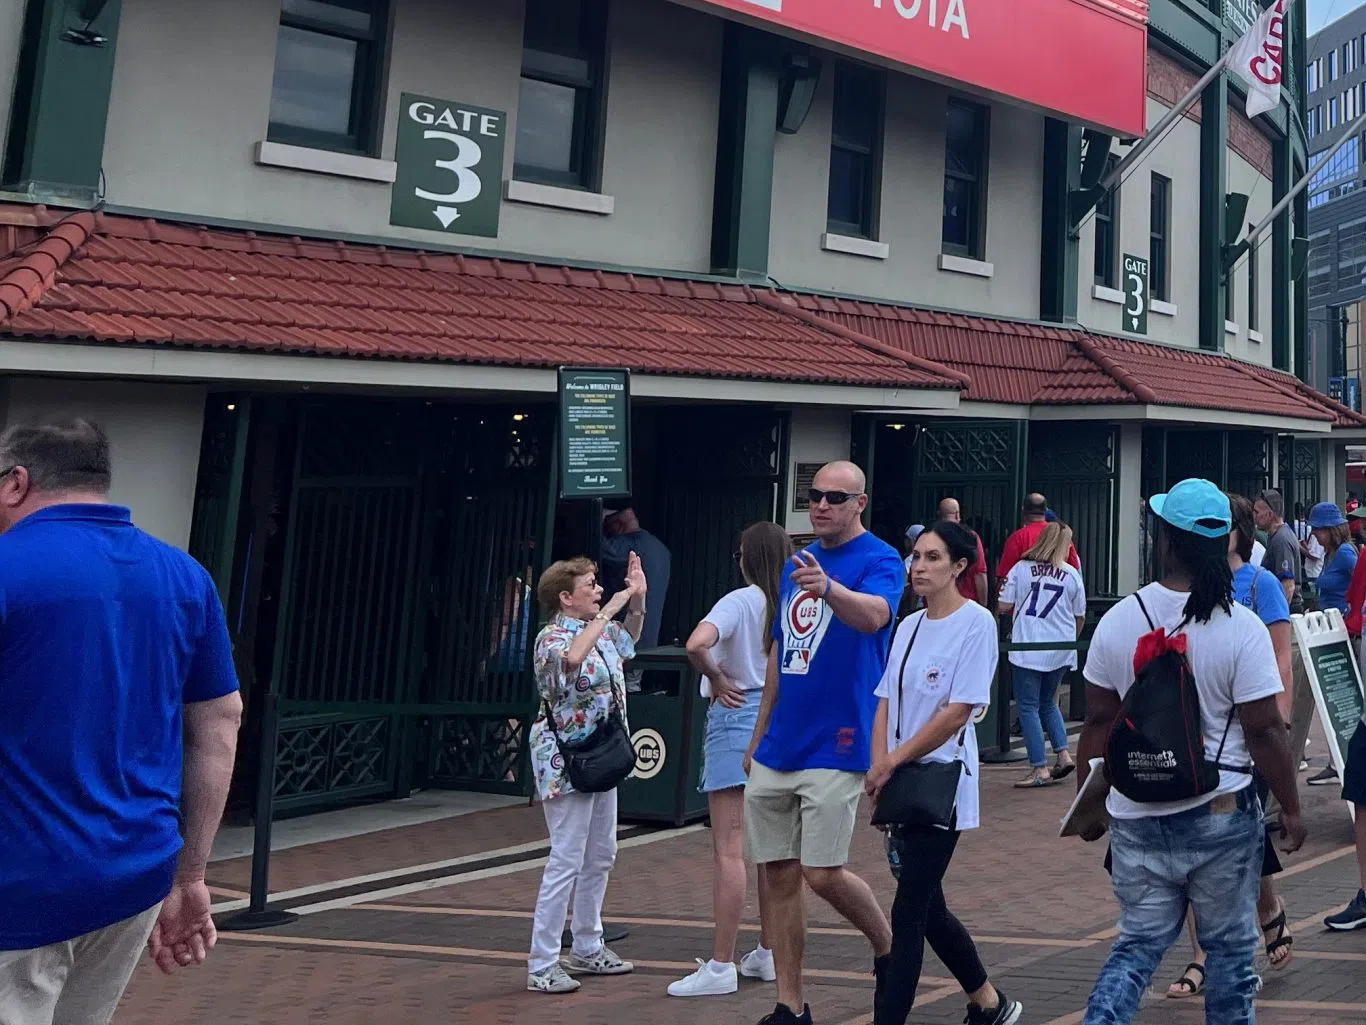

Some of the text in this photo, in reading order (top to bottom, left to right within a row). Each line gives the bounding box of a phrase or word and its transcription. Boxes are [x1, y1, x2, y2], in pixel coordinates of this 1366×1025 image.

[409, 102, 499, 137] GATE
[415, 130, 482, 203] 3
[1125, 258, 1147, 275] GATE
[1127, 274, 1144, 316] 3
[1030, 563, 1068, 581] BRYANT
[1025, 582, 1064, 619] 17
[1129, 758, 1177, 768] essentials
